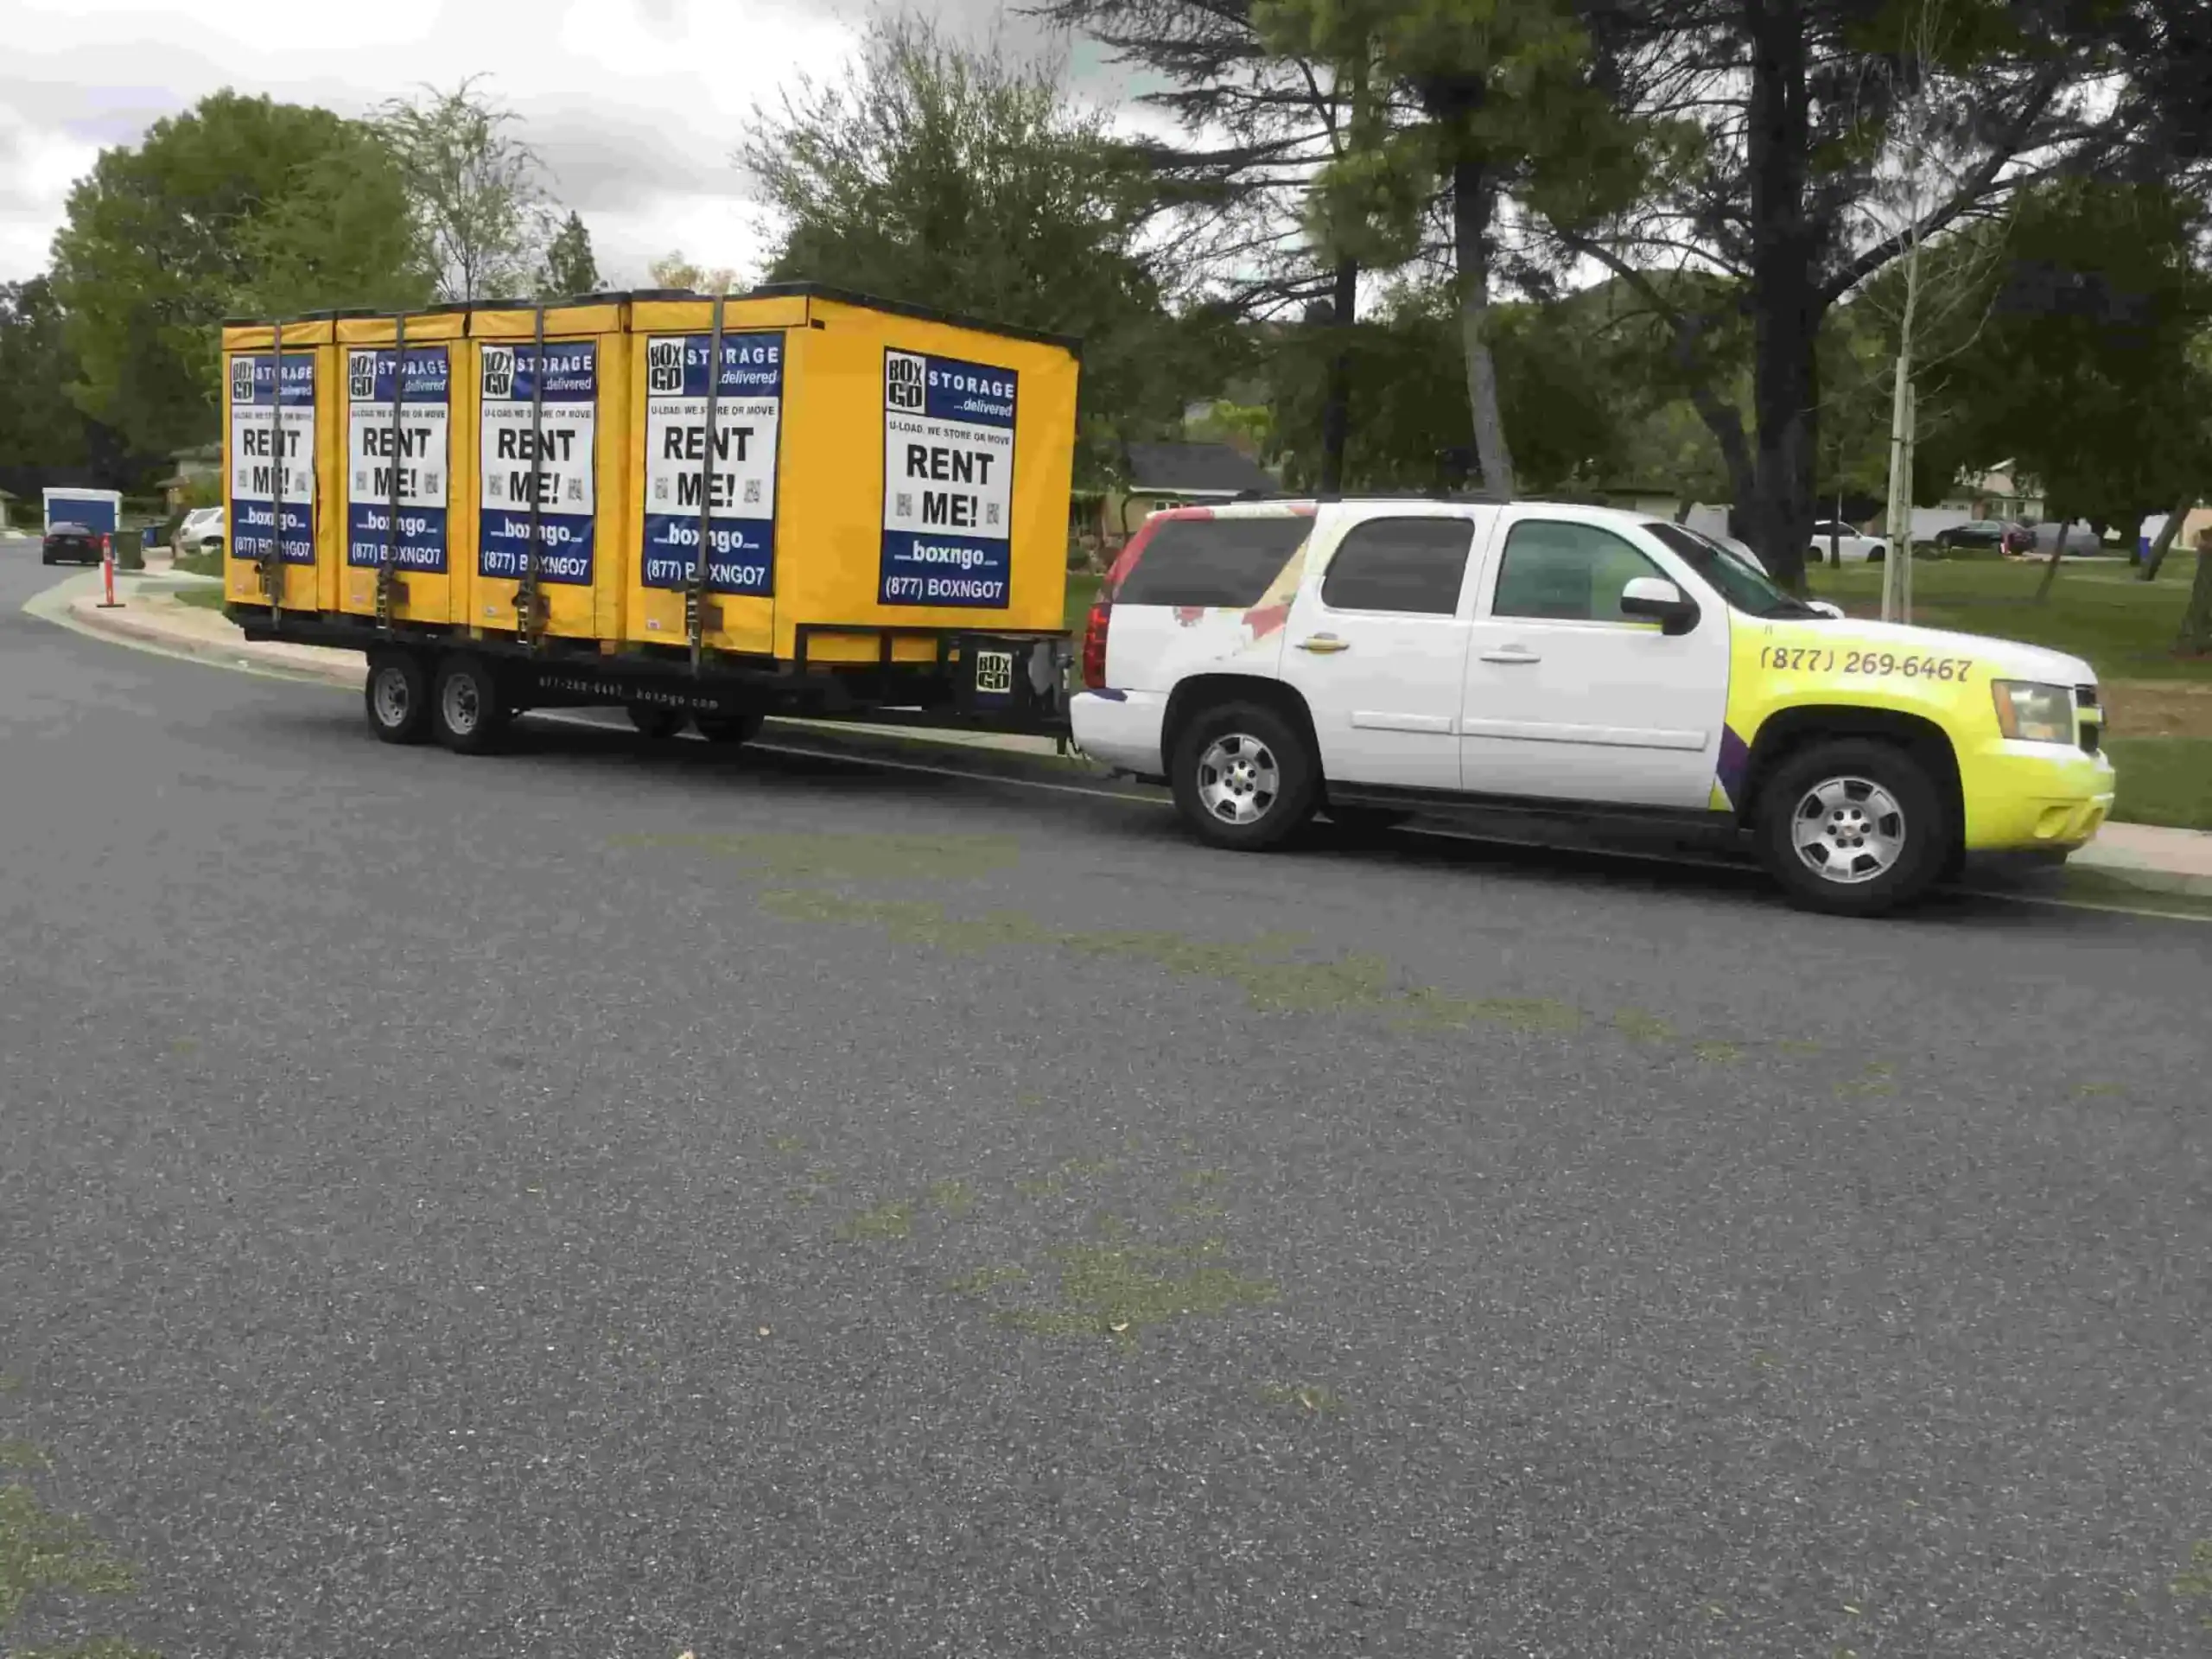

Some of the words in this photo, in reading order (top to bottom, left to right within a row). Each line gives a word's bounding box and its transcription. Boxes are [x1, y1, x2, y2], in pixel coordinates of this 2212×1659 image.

[650, 343, 681, 367] BOX
[687, 347, 779, 365] STRAGE
[651, 366, 682, 391] GO
[888, 358, 922, 386] BOX
[929, 369, 1014, 398] STORAGE
[351, 376, 372, 396] GO
[888, 382, 923, 408] GO
[569, 410, 592, 419] MOVE
[684, 406, 697, 415] WE
[699, 406, 729, 416] STRE
[731, 406, 744, 415] OR
[746, 406, 775, 416] MOVE
[363, 428, 432, 459] RENT
[498, 428, 575, 461] RENT
[664, 426, 754, 462] RENT
[927, 426, 941, 436] WE
[943, 427, 971, 440] STORE
[974, 433, 985, 442] OR
[987, 435, 1011, 446] MOVE
[906, 443, 995, 486] RENT
[373, 467, 416, 499] ME!
[509, 471, 561, 505] ME!
[677, 472, 736, 509] ME!
[921, 490, 979, 528] ME!
[235, 536, 257, 556] (877)
[258, 538, 310, 557] BONGO7
[352, 542, 378, 564] (877)
[484, 550, 516, 575] (877)
[518, 553, 588, 576] BXNGO7
[646, 558, 682, 582] (877)
[684, 560, 766, 587] BXNGO7
[885, 575, 924, 601] (877)
[926, 578, 1004, 599] BOXNGO7
[978, 656, 1010, 673] BOX
[1760, 646, 1834, 672] (877)
[1843, 652, 1973, 682] 269-6467
[978, 672, 1010, 690] GO
